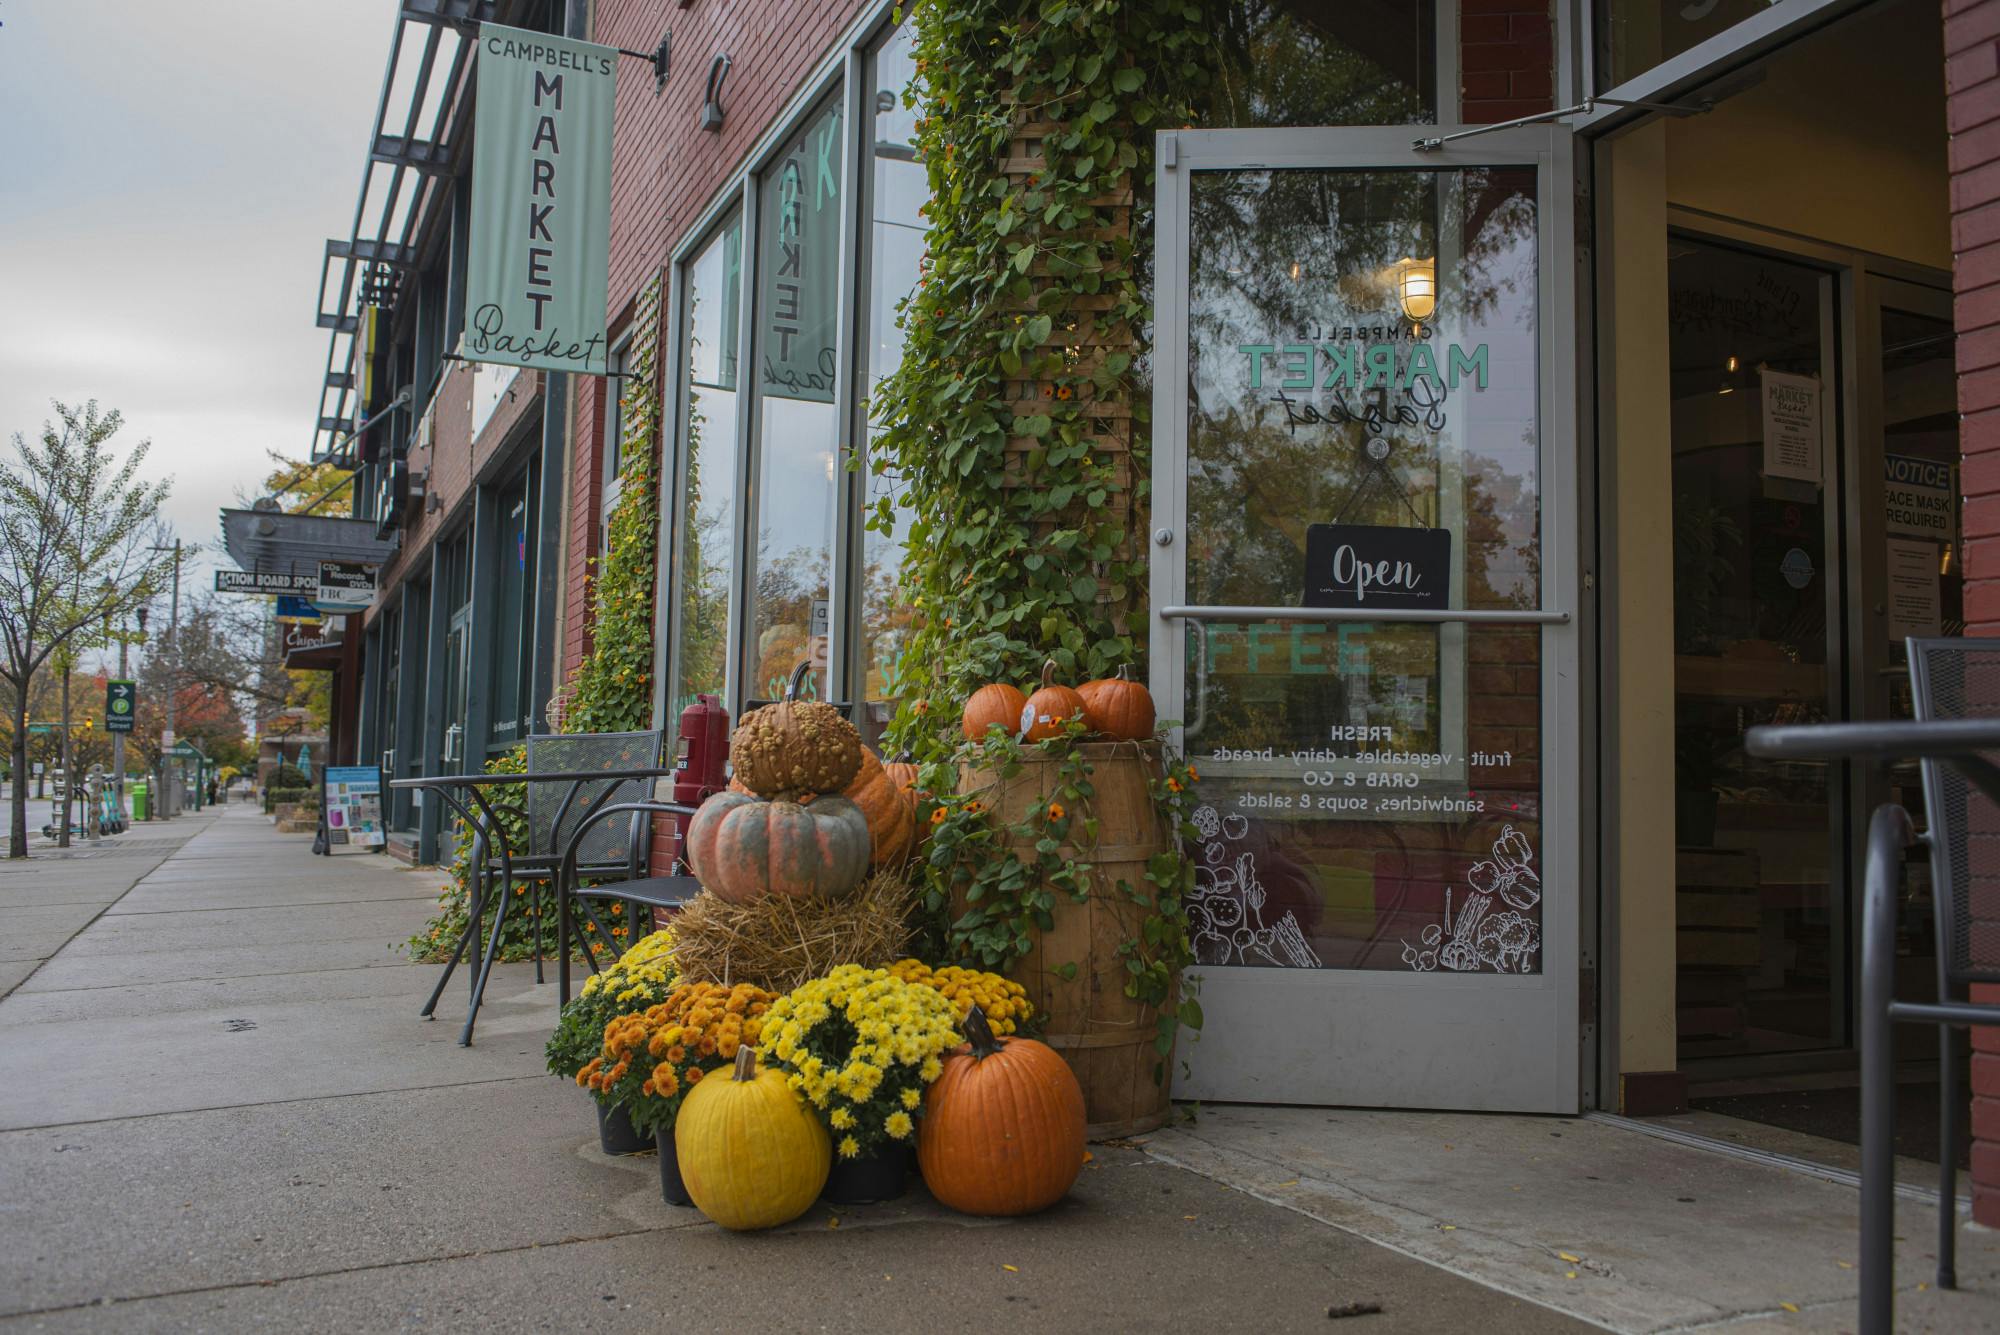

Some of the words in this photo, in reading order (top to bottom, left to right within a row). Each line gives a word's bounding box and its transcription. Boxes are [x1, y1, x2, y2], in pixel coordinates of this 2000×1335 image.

[487, 37, 611, 76] CAMPBELL'S
[526, 70, 563, 331] MARKET
[473, 303, 605, 371] Basket
[1885, 457, 1949, 487] NOTICE
[1886, 508, 1946, 529] REQUIRED
[1916, 495, 1950, 512] MASK
[257, 574, 290, 587] BOARD
[293, 575, 318, 588] SPOR
[330, 571, 366, 580] Records
[1332, 544, 1422, 601] Open
